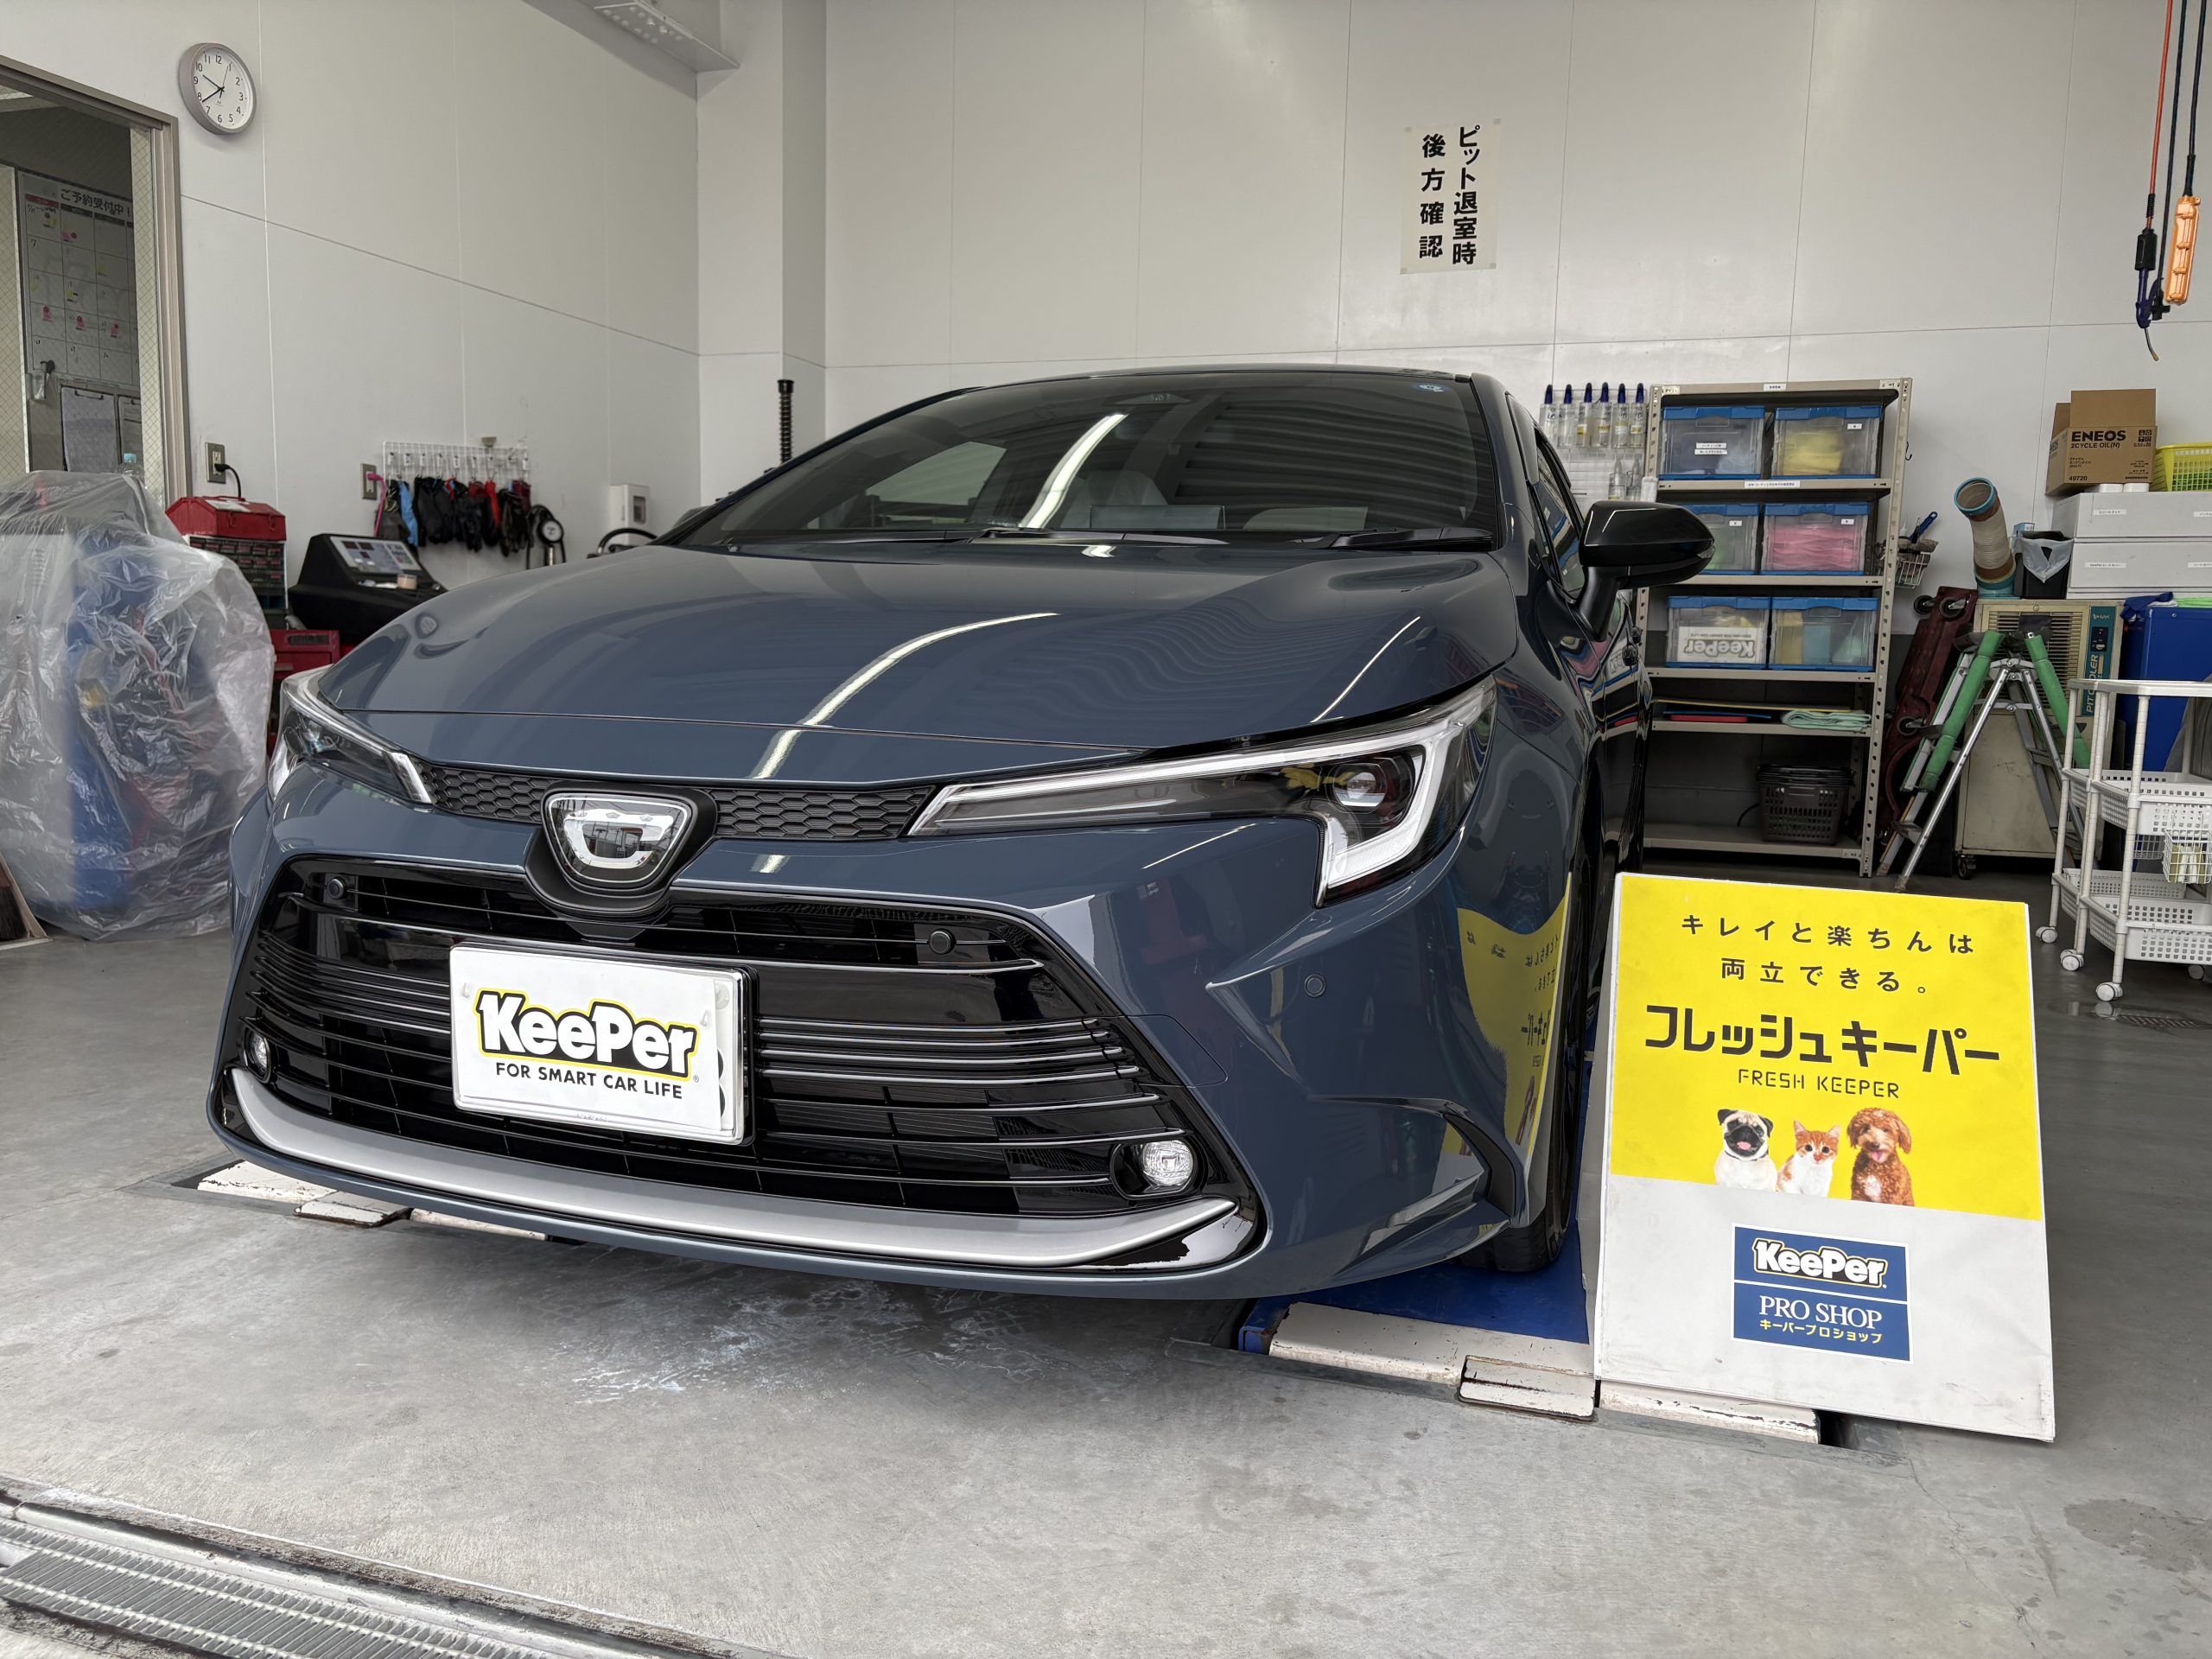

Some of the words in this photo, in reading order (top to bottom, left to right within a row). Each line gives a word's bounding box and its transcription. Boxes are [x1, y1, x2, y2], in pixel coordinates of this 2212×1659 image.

[195, 62, 203, 72] 10
[215, 54, 222, 64] 12
[193, 75, 199, 84] 9
[235, 76, 240, 86] 2
[197, 92, 202, 101] 8
[238, 92, 244, 101] 3
[206, 105, 211, 114] 7
[217, 114, 222, 123] 6
[229, 113, 233, 123] 5
[1419, 133, 1446, 259] 後方確認
[1452, 124, 1481, 265] ピット退室時
[2071, 430, 2126, 442] ENEOS
[1683, 639, 1756, 658] KeePer
[1681, 914, 1974, 954] キレイと楽ちんは
[1720, 957, 1927, 995] 両立できる。
[475, 989, 698, 1079] KeePer
[1645, 1004, 2000, 1076] フレッシュキーパー
[496, 1062, 531, 1079] FOR
[538, 1066, 597, 1086] SMART
[604, 1074, 638, 1092] CAR
[645, 1079, 683, 1099] LIFE
[1738, 1068, 1805, 1090] FRESH
[1817, 1076, 1900, 1099] KEEPER
[1751, 1237, 1887, 1288] KeePer
[1758, 1294, 1810, 1320] PRO
[1815, 1303, 1882, 1330] SHOP
[1759, 1319, 1883, 1344] キーパープロショップ
